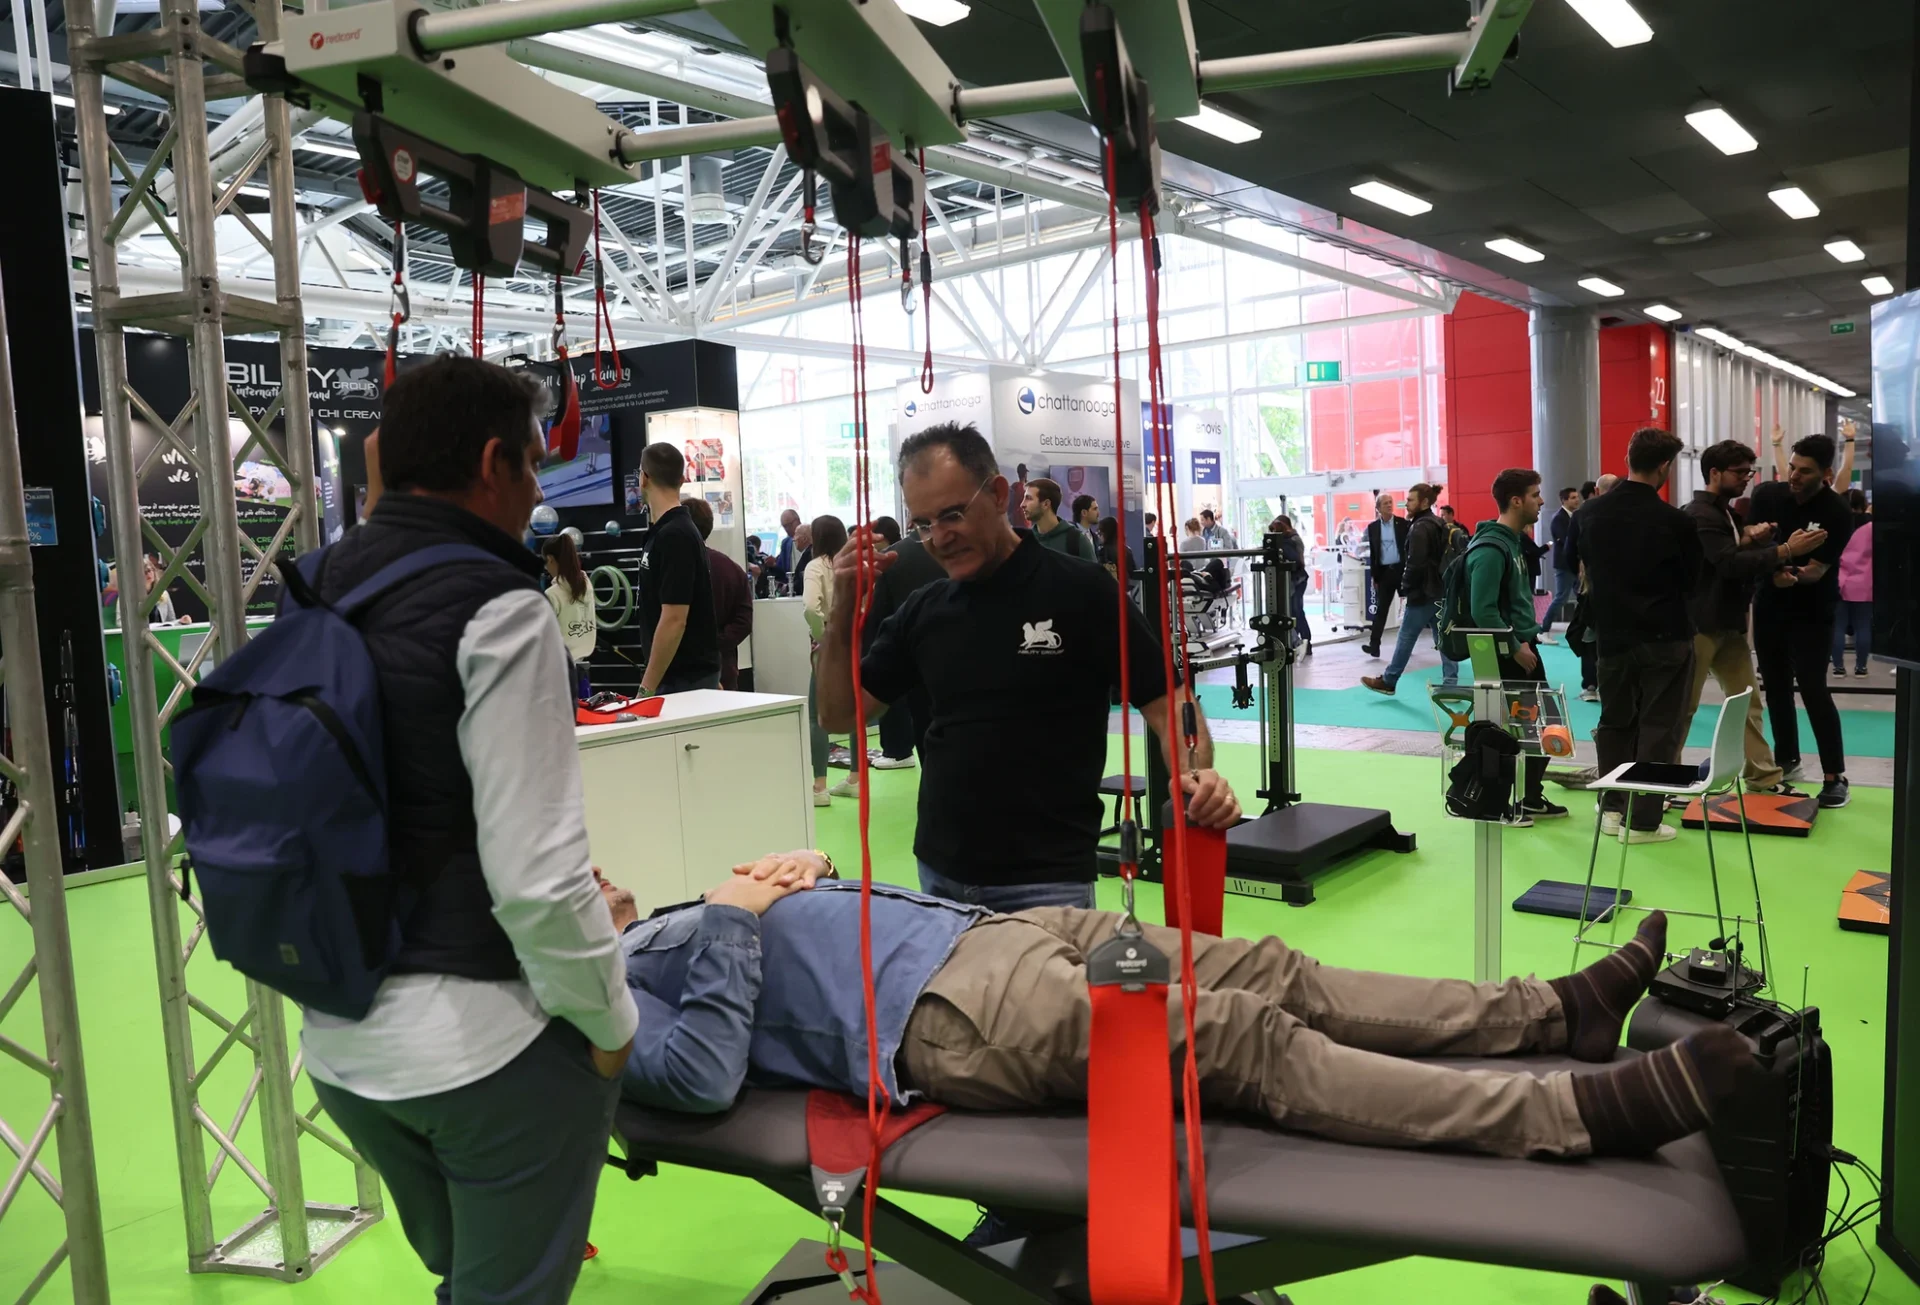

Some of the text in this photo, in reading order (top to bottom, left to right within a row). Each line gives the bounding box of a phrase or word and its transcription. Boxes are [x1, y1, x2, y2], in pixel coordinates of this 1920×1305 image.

[236, 384, 331, 402] internati rand
[332, 381, 375, 390] GROUP
[918, 395, 981, 412] chattanooga
[1038, 392, 1116, 417] chattanooga
[318, 409, 340, 418] CHI
[1040, 433, 1053, 446] Get
[1054, 435, 1072, 447] back
[1073, 436, 1081, 447] to
[1082, 436, 1099, 448] what
[1101, 439, 1115, 451] you
[1115, 958, 1148, 969] redcord
